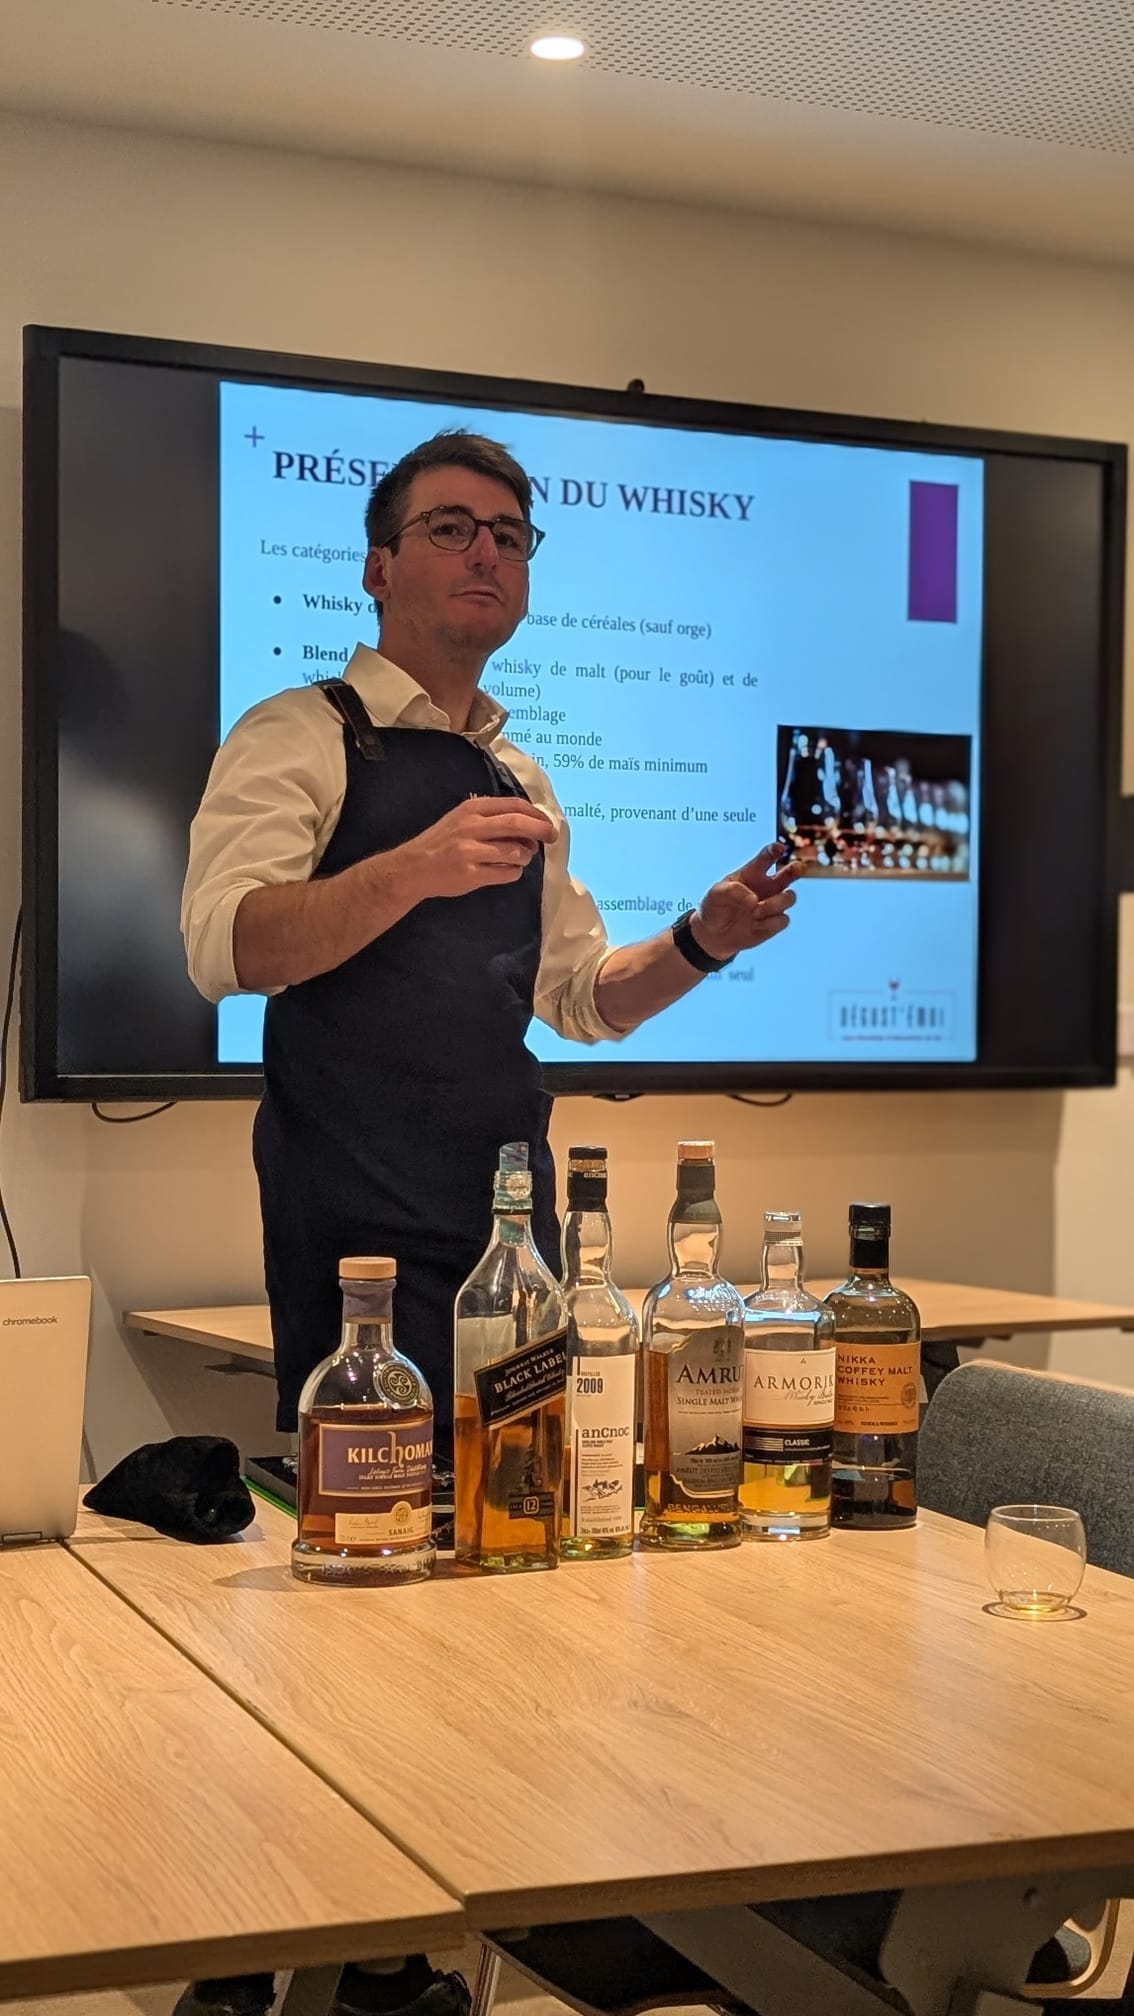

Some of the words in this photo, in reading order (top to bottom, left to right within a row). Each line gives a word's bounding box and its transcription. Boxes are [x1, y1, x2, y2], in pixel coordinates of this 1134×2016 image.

[560, 478, 608, 508] DU
[617, 484, 755, 521] WHISKY
[260, 540, 288, 556] Les
[292, 544, 367, 564] catégories
[303, 594, 363, 616] Whisky
[527, 612, 557, 626] base
[562, 613, 577, 627] de
[582, 615, 636, 632] céréales
[640, 618, 674, 635] (sauf
[677, 623, 712, 640] orge)
[303, 645, 348, 662] Blend
[492, 659, 541, 678] whisky
[550, 663, 566, 676] de
[575, 664, 606, 678] malt
[614, 665, 651, 683] (pour
[659, 667, 671, 681] le
[679, 669, 714, 687] goût)
[722, 673, 735, 686] et
[742, 673, 759, 687] de
[484, 682, 541, 701] volume)
[509, 706, 566, 726] emblage
[536, 733, 552, 744] au
[556, 732, 602, 746] monde
[553, 753, 585, 770] 59%
[589, 755, 604, 769] de
[609, 757, 640, 771] maïs
[644, 758, 708, 774] minimum
[564, 803, 606, 820] malté,
[610, 806, 677, 823] provenant
[723, 808, 757, 822] seule
[597, 896, 673, 916] assemblage
[2, 1315, 58, 1326] chromebook
[838, 1354, 876, 1365] NIKKA
[676, 1364, 743, 1384] AMRU
[837, 1366, 884, 1376] COFFEY
[888, 1366, 913, 1375] MALT
[494, 1369, 532, 1394] BLACK
[576, 1378, 603, 1393] 2009
[837, 1376, 886, 1386] WHISKY
[677, 1396, 707, 1406] SINGLE
[709, 1397, 729, 1406] MALT
[582, 1426, 630, 1439] anCnoc
[527, 1500, 537, 1511] 12
